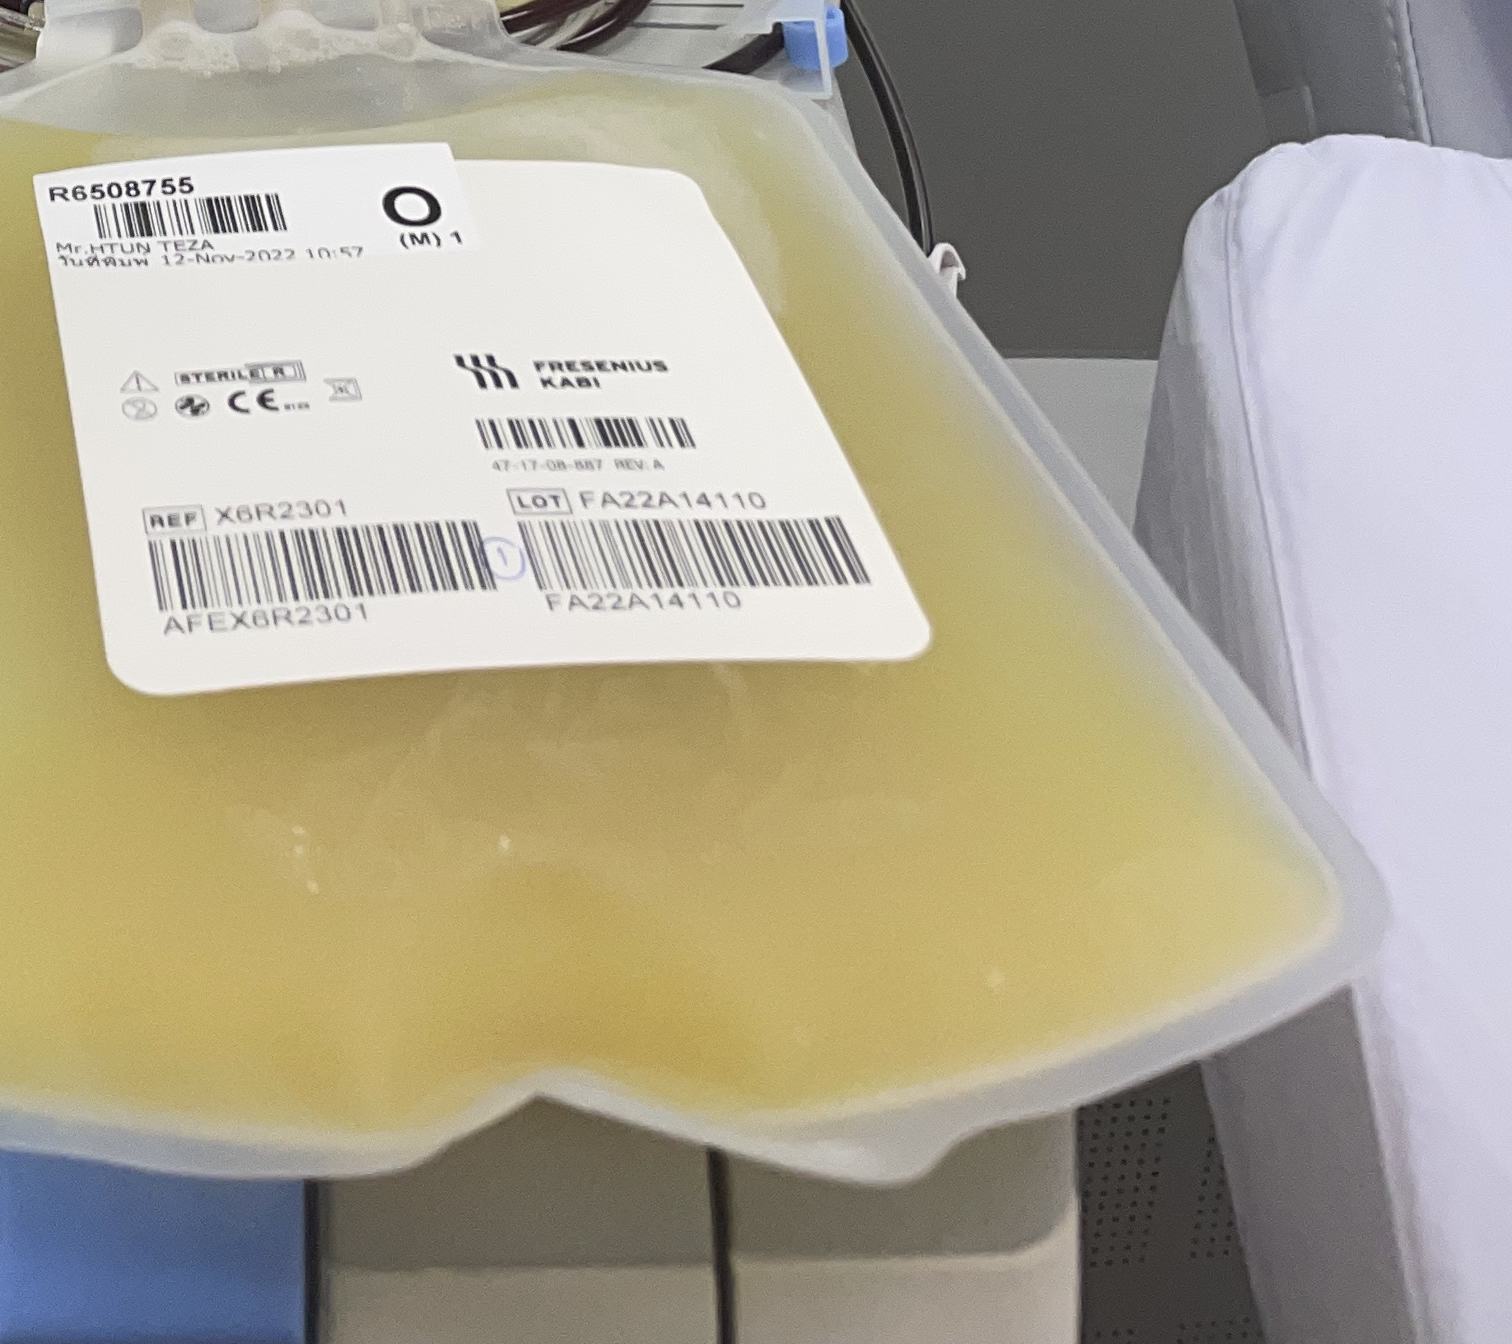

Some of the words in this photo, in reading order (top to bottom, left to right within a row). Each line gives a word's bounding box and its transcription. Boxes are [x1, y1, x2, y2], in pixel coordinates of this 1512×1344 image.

[49, 176, 195, 203] R6508755
[382, 185, 442, 227] O
[157, 238, 215, 252] TEZA
[399, 231, 441, 250] (M)
[450, 230, 463, 245] 1
[161, 248, 296, 266] 12-Nov-2022
[306, 245, 363, 261] 10:57
[179, 365, 262, 385] STERILE
[533, 359, 669, 373] FRESENIUS
[540, 376, 601, 389] KABI
[516, 494, 562, 509] LOT
[580, 491, 767, 511] FA22A14110
[150, 510, 198, 529] REF
[216, 498, 349, 525] X6R2301
[546, 590, 742, 611] FA22A14110
[164, 602, 368, 636] AFEX6R2301
